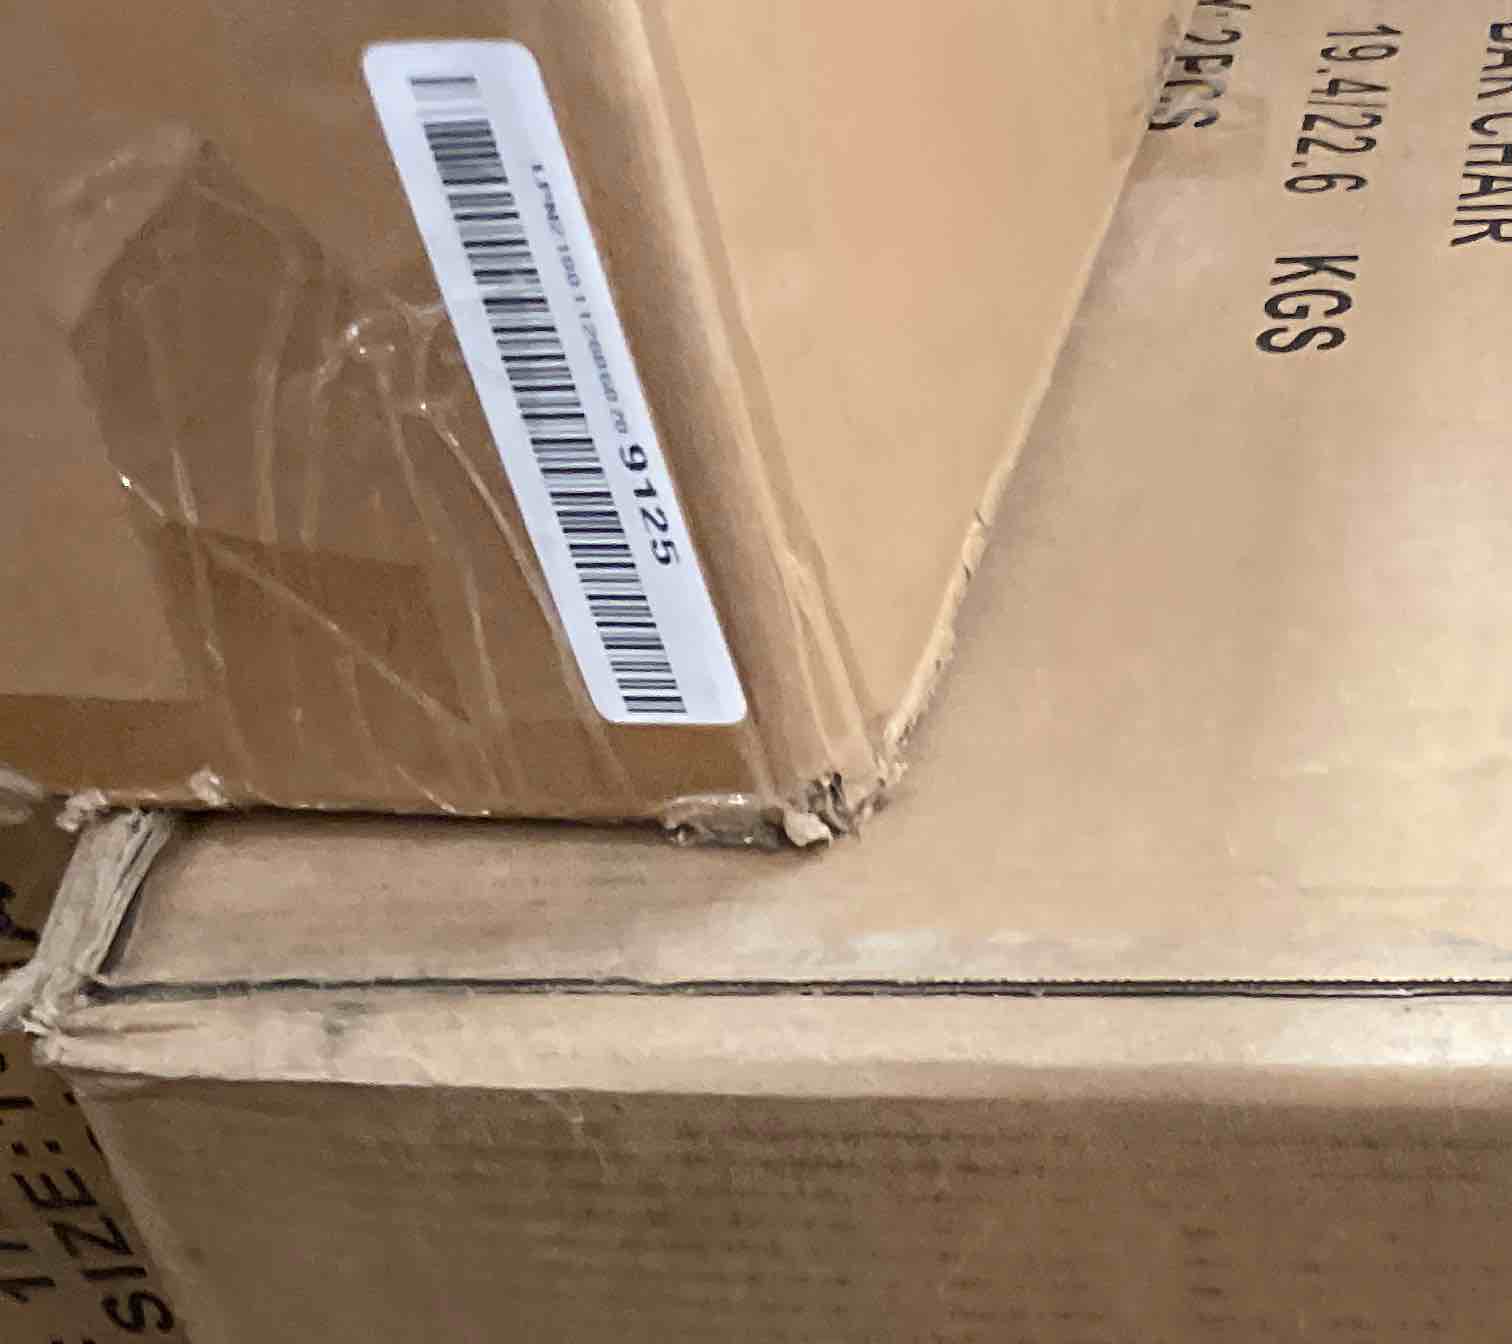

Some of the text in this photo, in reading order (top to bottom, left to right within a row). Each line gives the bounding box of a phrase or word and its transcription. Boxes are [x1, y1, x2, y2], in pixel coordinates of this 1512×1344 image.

[1284, 23, 1403, 195] 19.4/22.6
[1256, 254, 1360, 354] KGS
[11, 1140, 174, 1333] SIZE:
